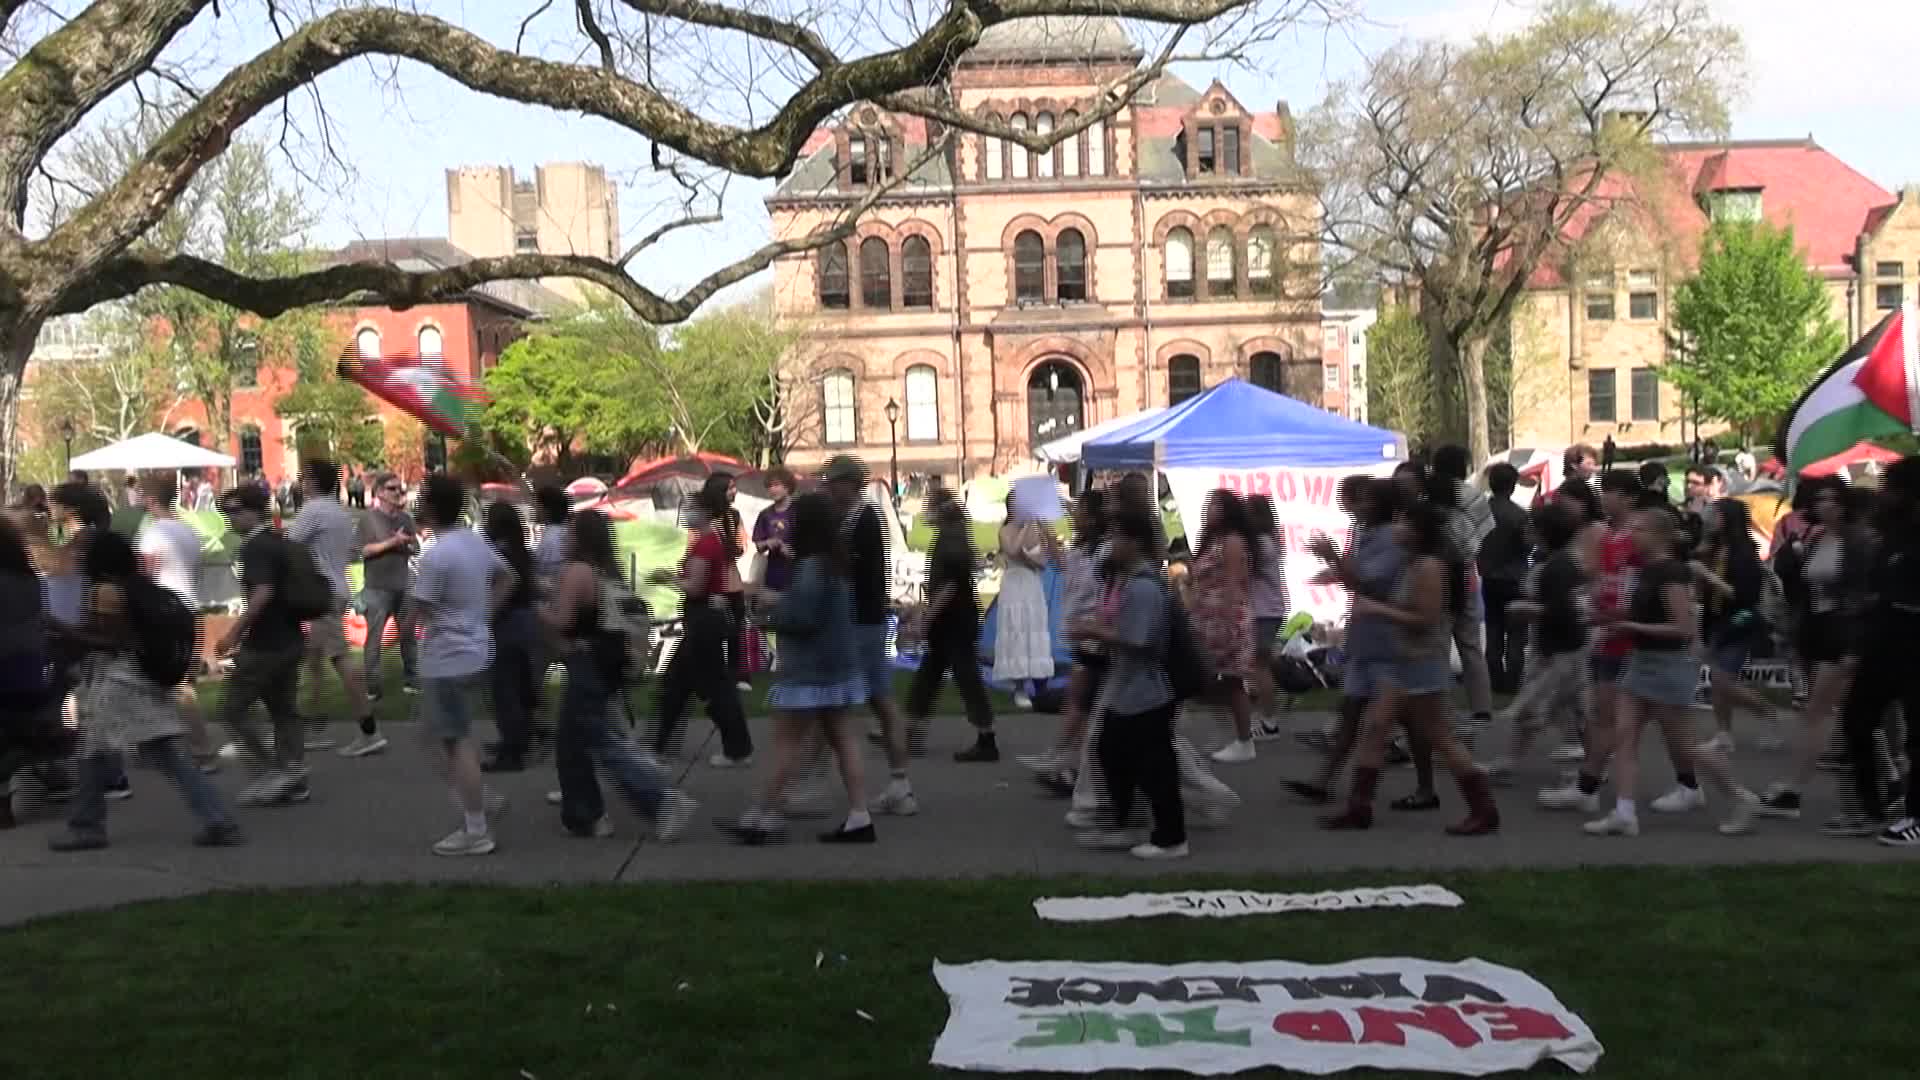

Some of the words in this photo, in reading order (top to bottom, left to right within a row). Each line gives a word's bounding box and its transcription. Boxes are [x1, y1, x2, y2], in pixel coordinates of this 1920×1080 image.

[1219, 472, 1335, 505] BROW
[1173, 895, 1249, 910] LIVE
[1007, 973, 1509, 1006] VIOLENCE
[1010, 1004, 1252, 1048] THE
[1271, 1001, 1575, 1049] END
